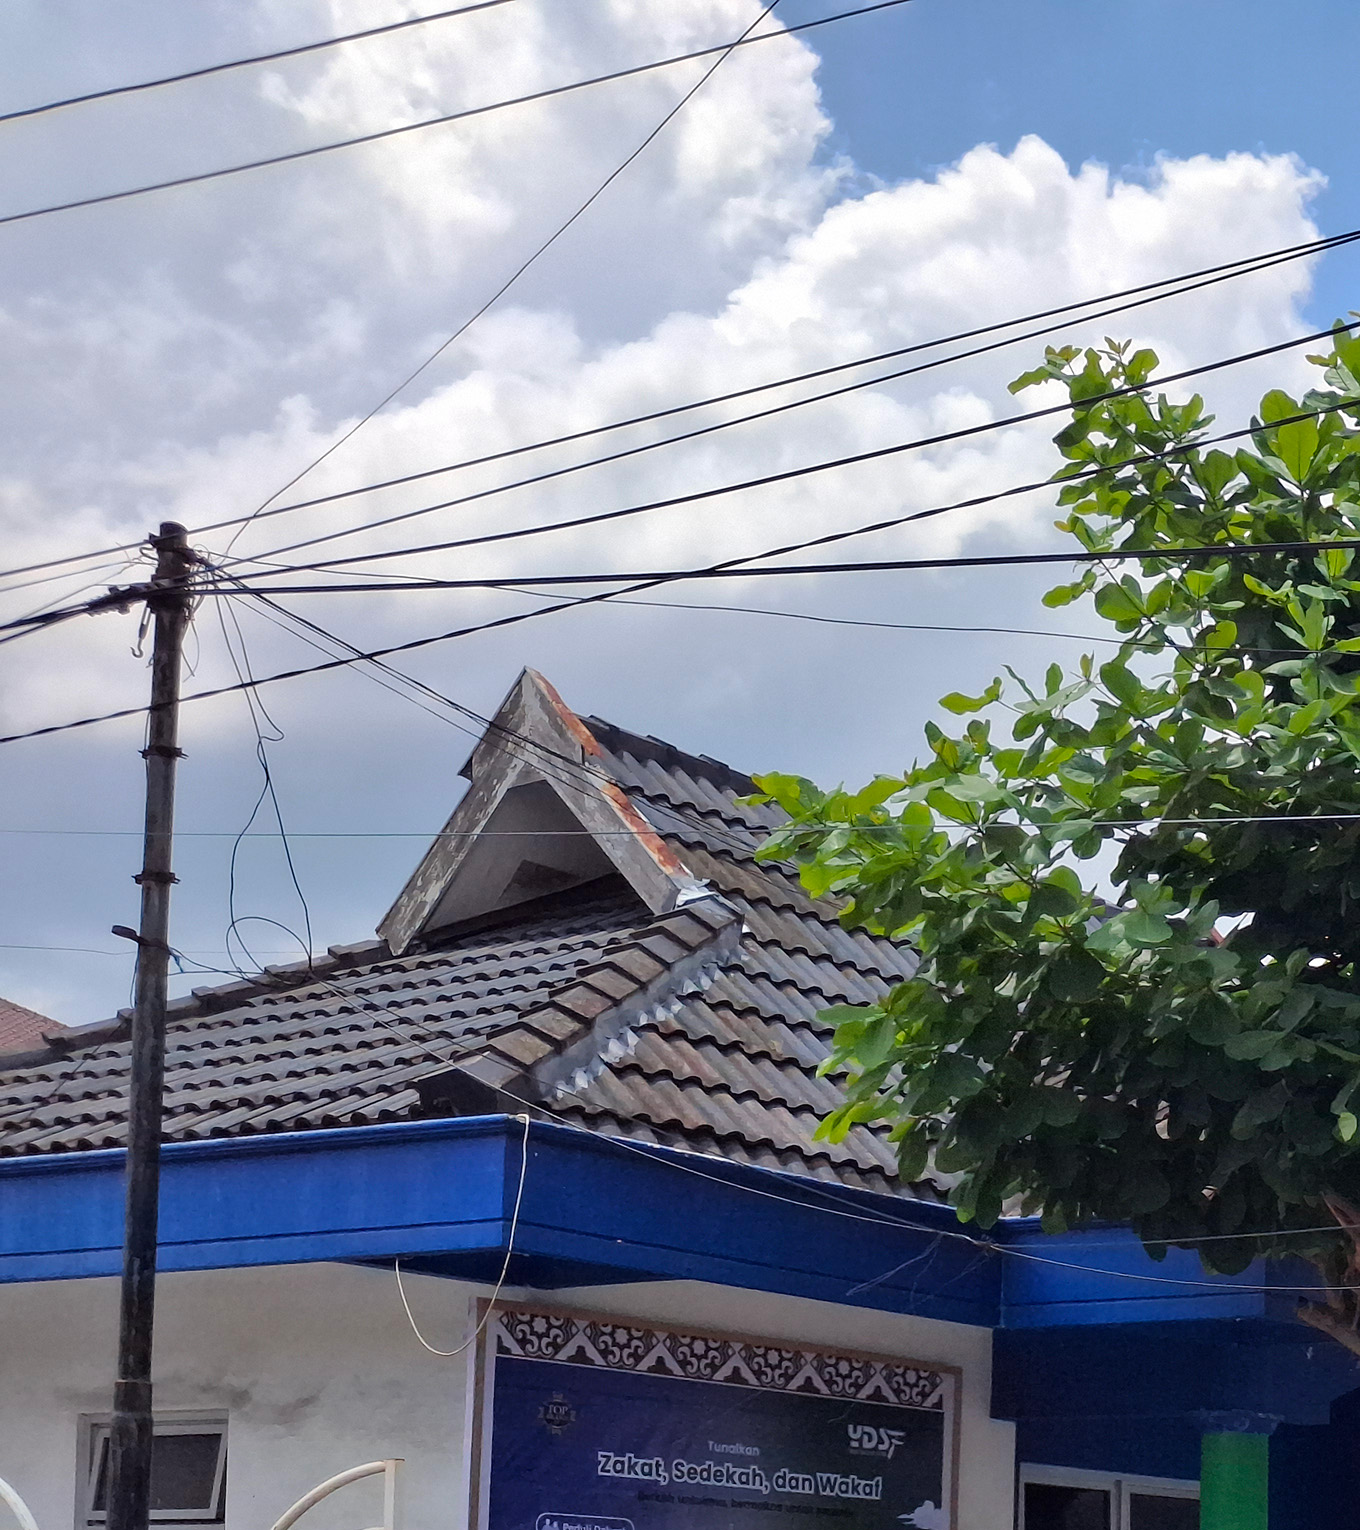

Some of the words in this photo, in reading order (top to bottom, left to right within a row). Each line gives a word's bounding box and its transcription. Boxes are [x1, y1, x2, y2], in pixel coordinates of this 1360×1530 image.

[707, 1440, 760, 1456] Tunaikan
[847, 1424, 906, 1460] YDSF
[598, 1451, 668, 1487] Zakat,
[672, 1458, 771, 1495] Sedekah,
[774, 1467, 813, 1494] dan
[815, 1472, 883, 1499] Wakaf
